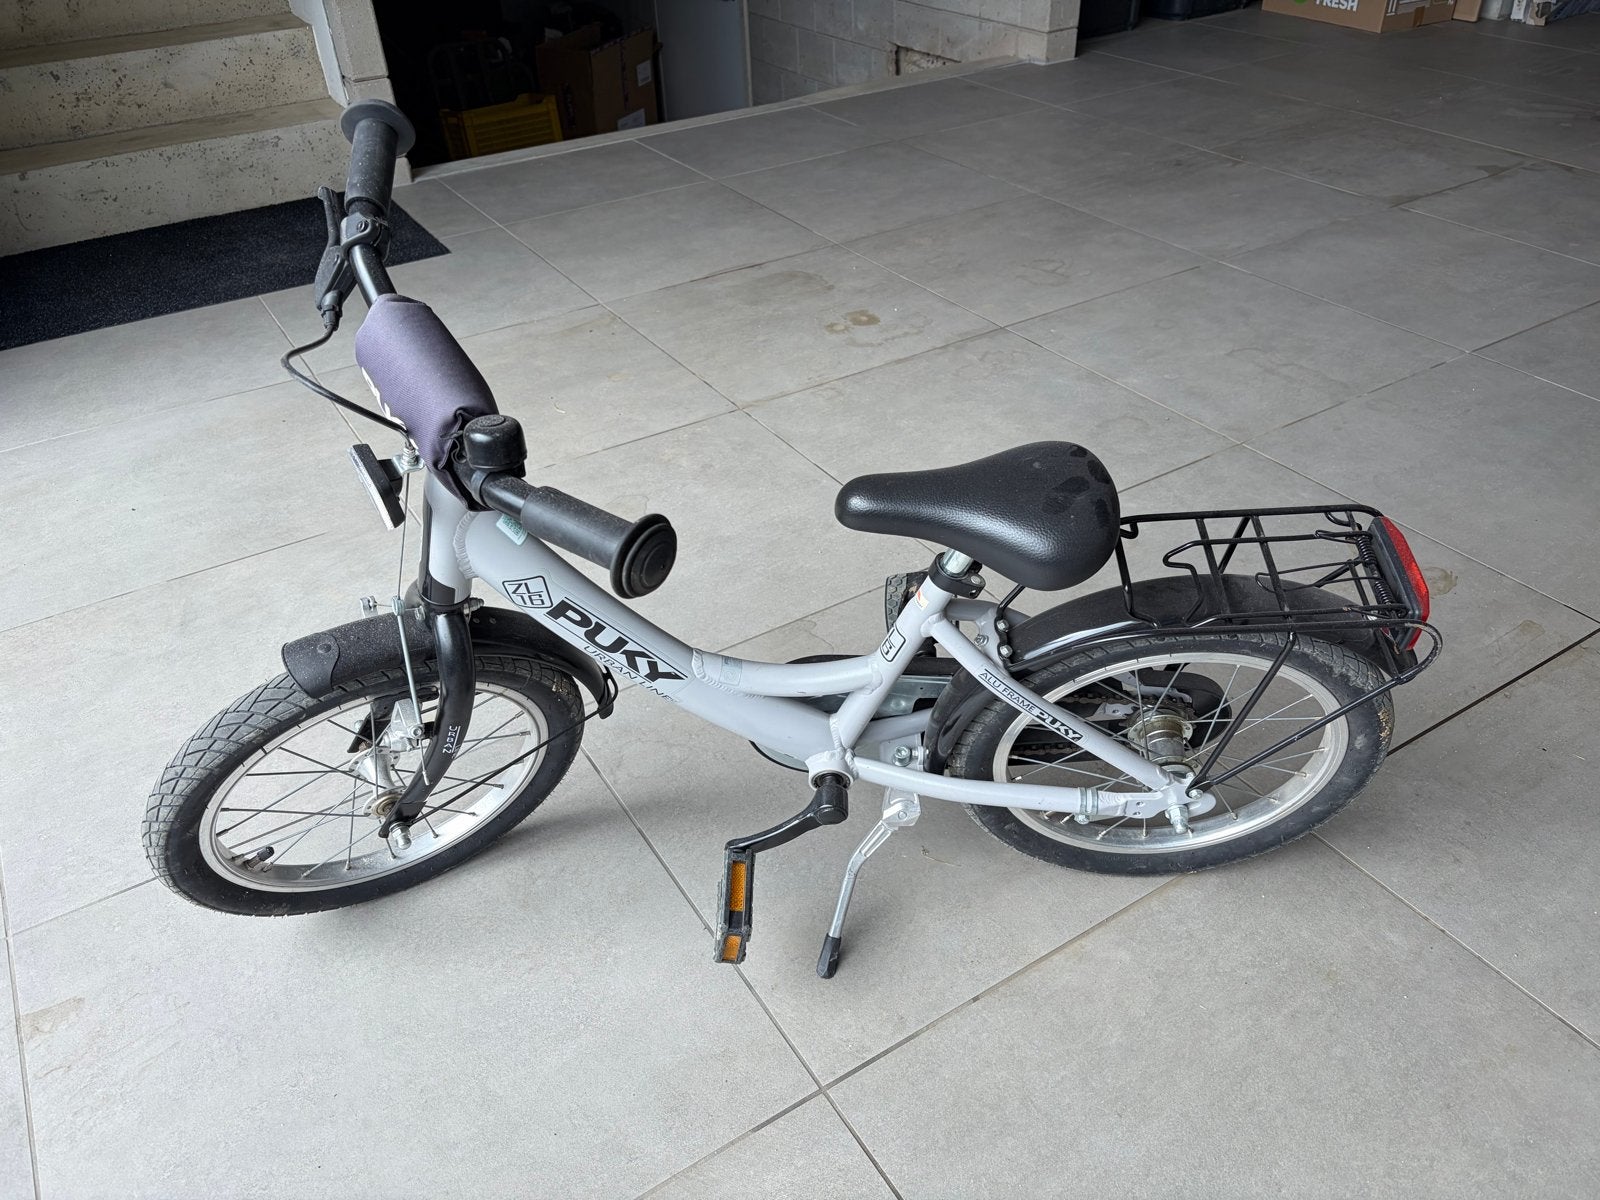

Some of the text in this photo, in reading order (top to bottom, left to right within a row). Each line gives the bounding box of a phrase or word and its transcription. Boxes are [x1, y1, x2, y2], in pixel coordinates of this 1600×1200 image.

[507, 582, 544, 595] ZL
[515, 593, 546, 606] 16
[545, 599, 686, 683] PUKY
[583, 645, 638, 680] URBAN
[980, 672, 1082, 742] ALU FRAME PUKY
